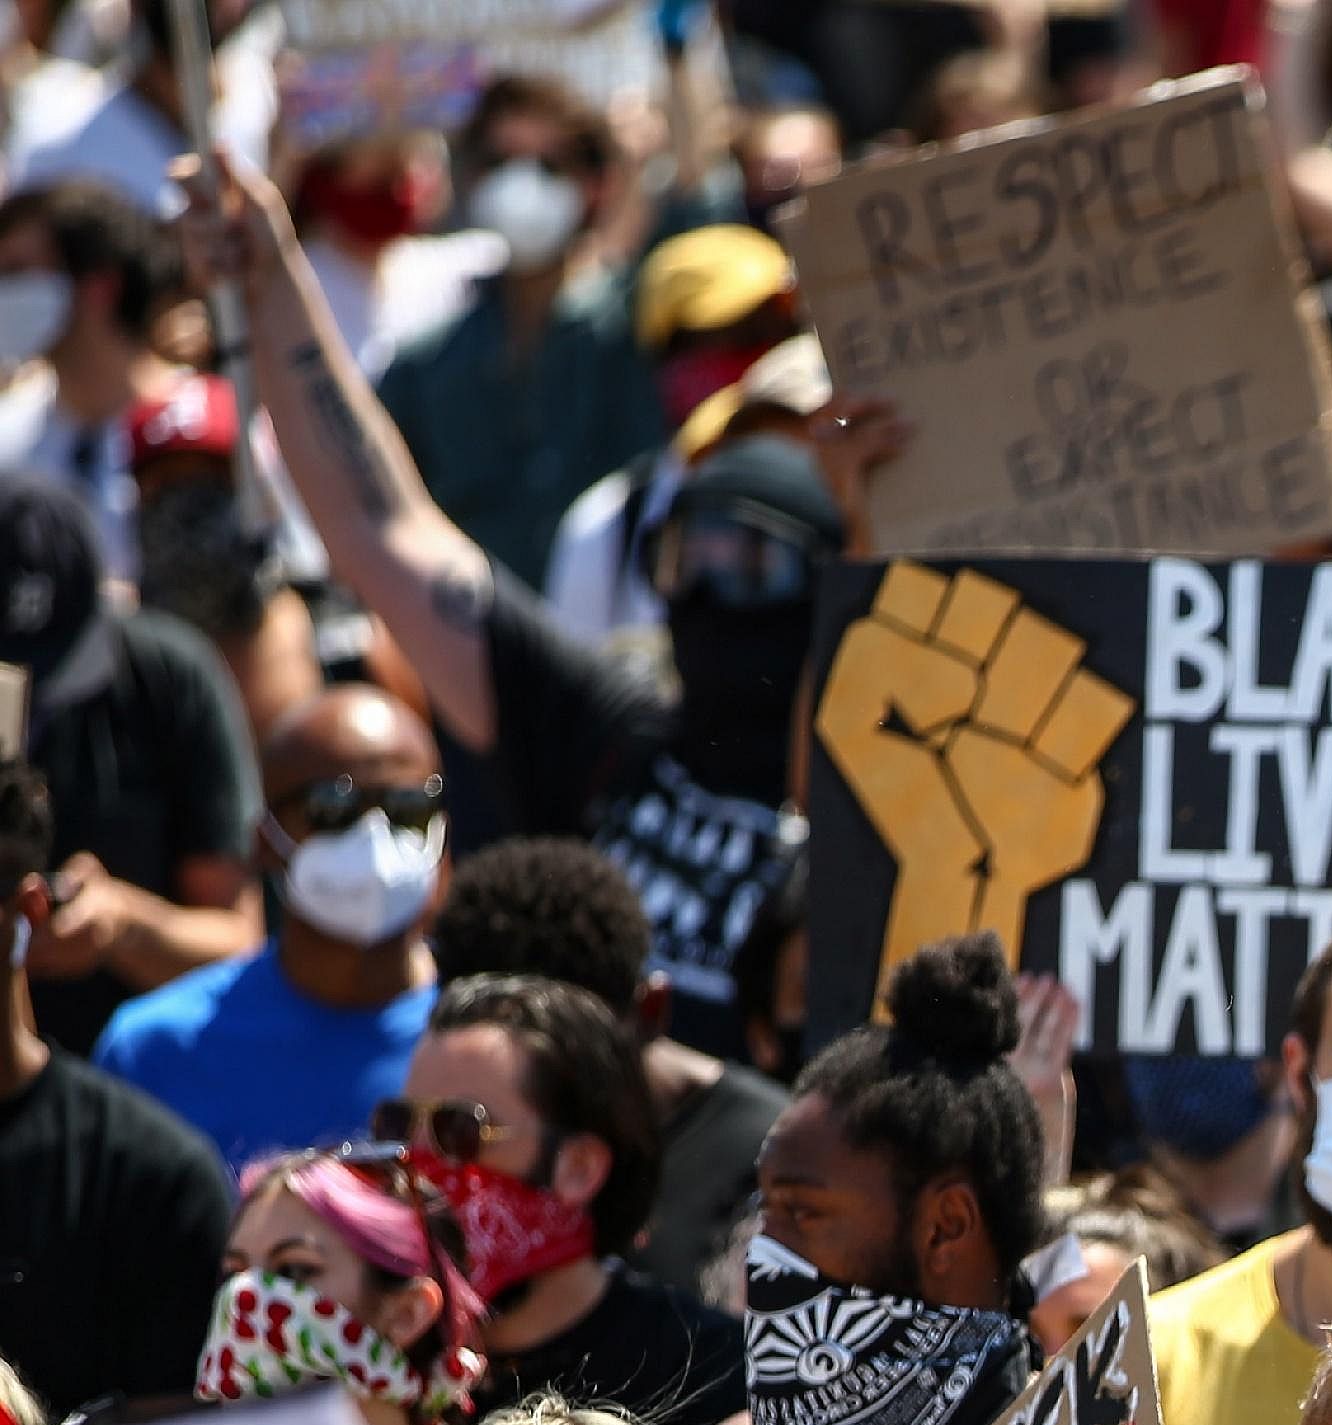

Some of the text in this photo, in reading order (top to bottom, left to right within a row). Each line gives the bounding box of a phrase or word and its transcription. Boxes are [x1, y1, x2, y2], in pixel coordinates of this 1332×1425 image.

[853, 95, 1250, 309] RESPECT
[838, 225, 1235, 385] EXISTENCE
[1007, 369, 1252, 500] EXPECT
[1033, 340, 1150, 425] OR
